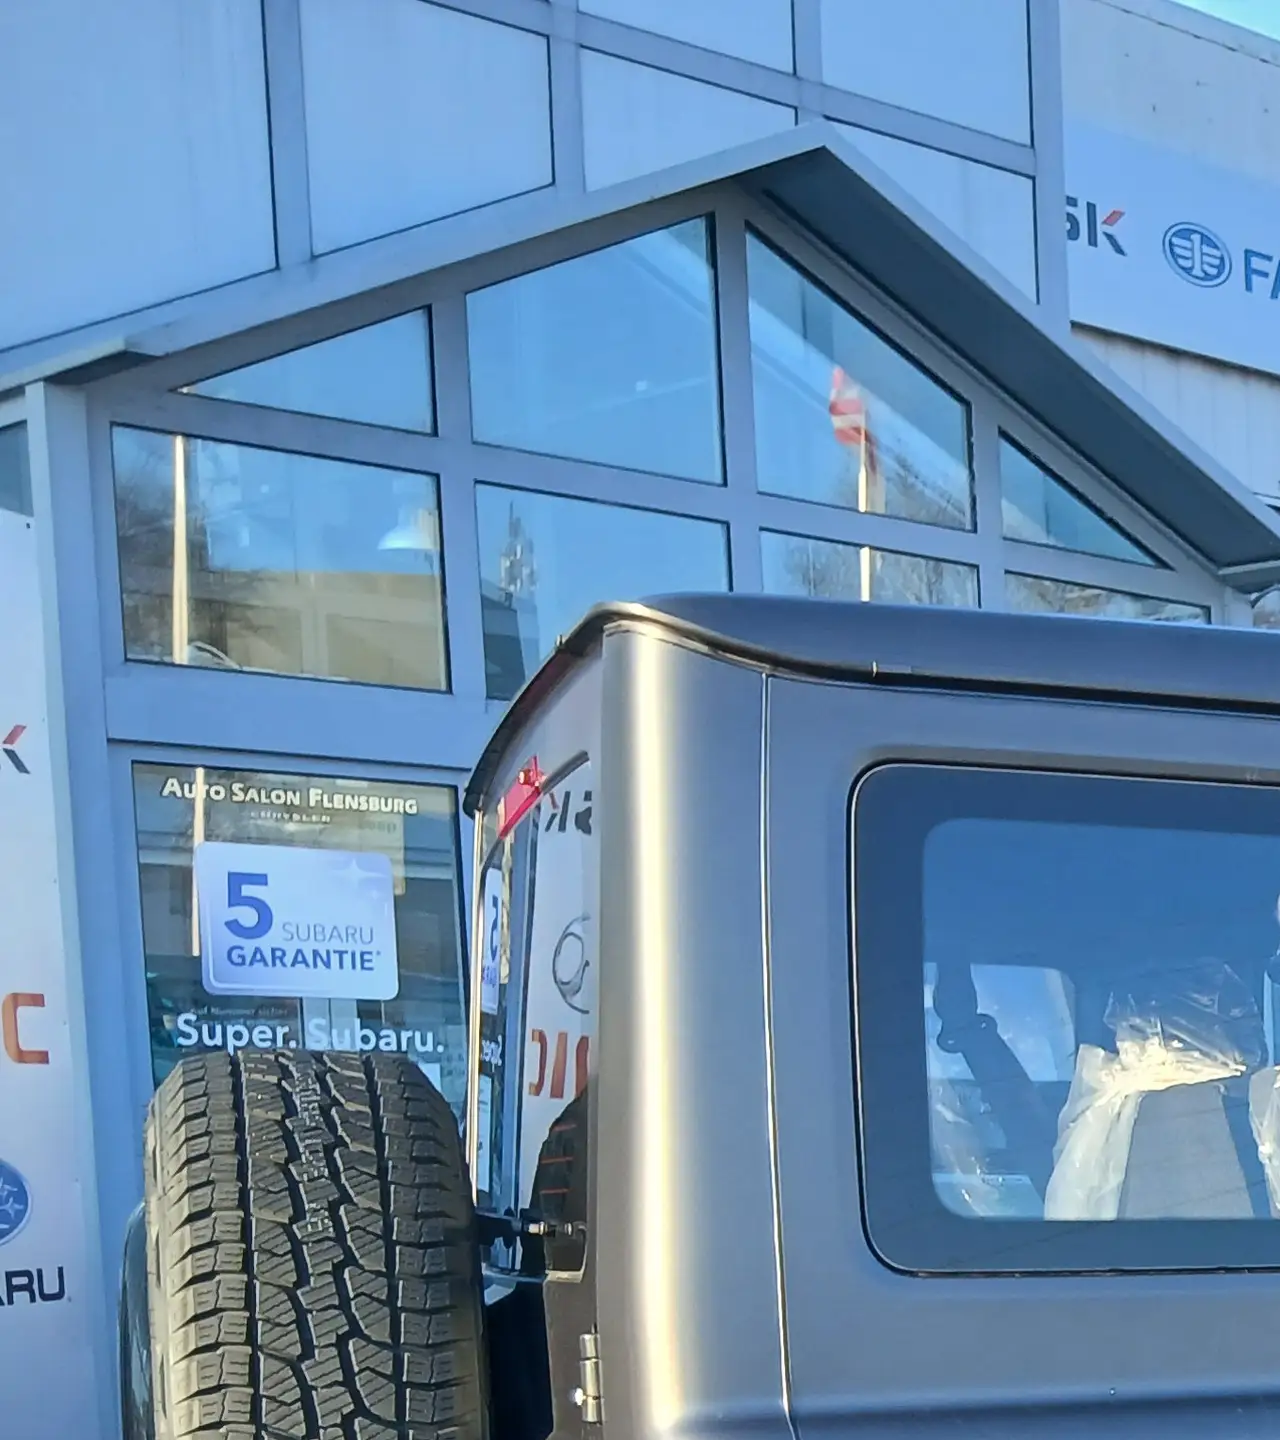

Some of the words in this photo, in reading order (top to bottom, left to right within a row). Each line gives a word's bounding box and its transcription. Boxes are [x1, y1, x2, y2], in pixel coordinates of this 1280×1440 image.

[231, 782, 300, 807] SALON
[308, 787, 418, 815] FLENSBURG
[224, 871, 273, 940] 5
[281, 921, 375, 945] SUBARU
[176, 1012, 297, 1056] Super.
[306, 1017, 445, 1053] Subaru.
[0, 1266, 66, 1306] RU
